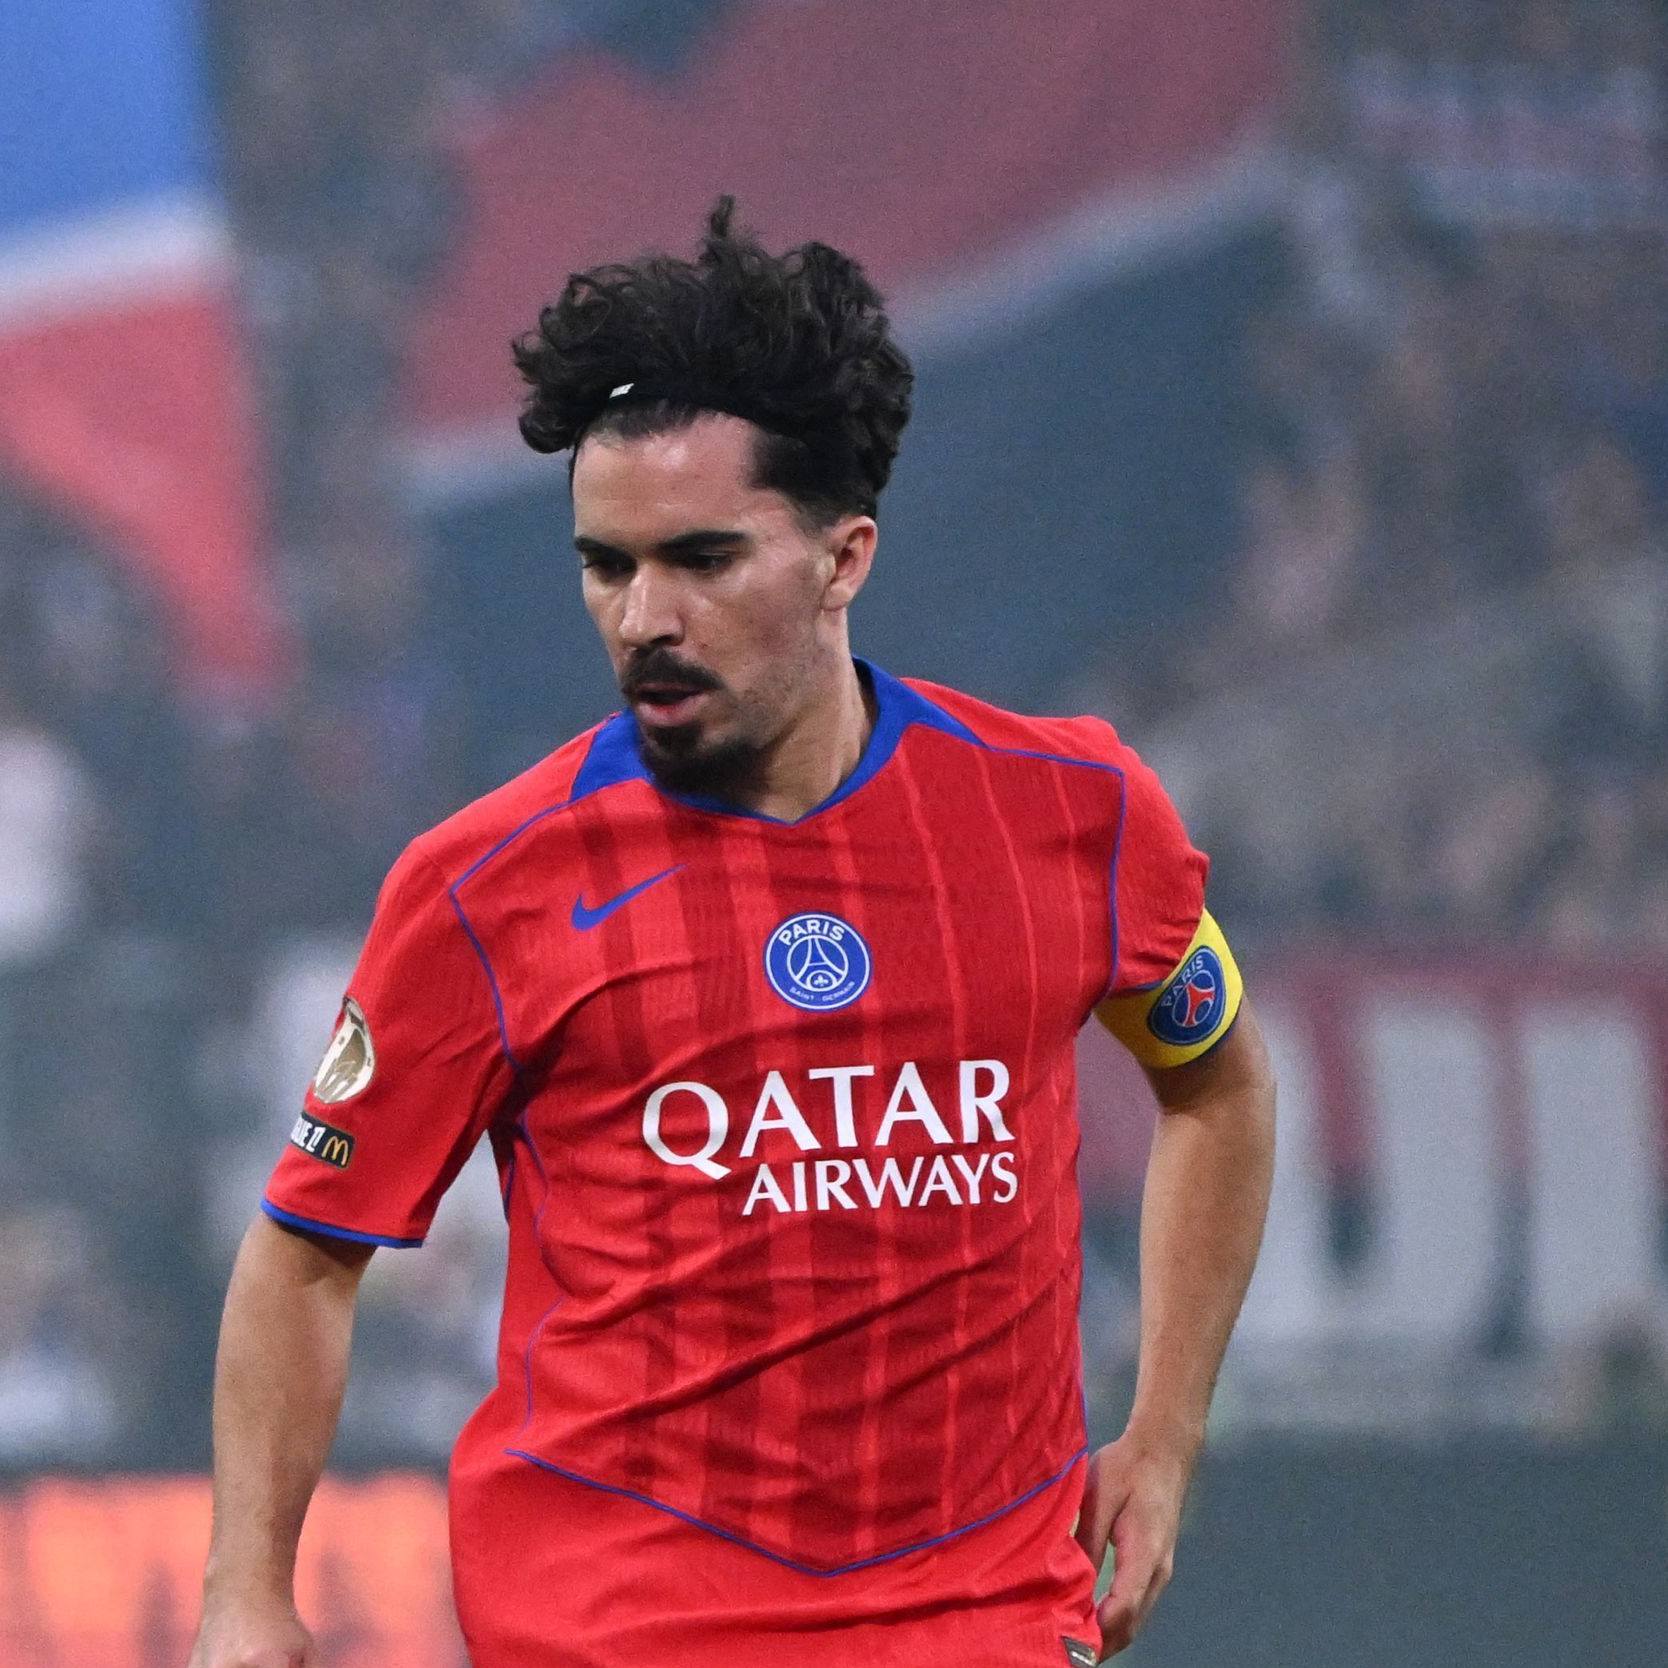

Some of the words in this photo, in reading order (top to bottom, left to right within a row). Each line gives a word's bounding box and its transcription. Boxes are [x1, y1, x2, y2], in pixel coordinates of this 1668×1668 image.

[778, 919, 845, 946] PARIS
[1161, 955, 1204, 1007] PARIS
[642, 1059, 1016, 1180] QATAR
[742, 1151, 1018, 1216] AIRWAYS
